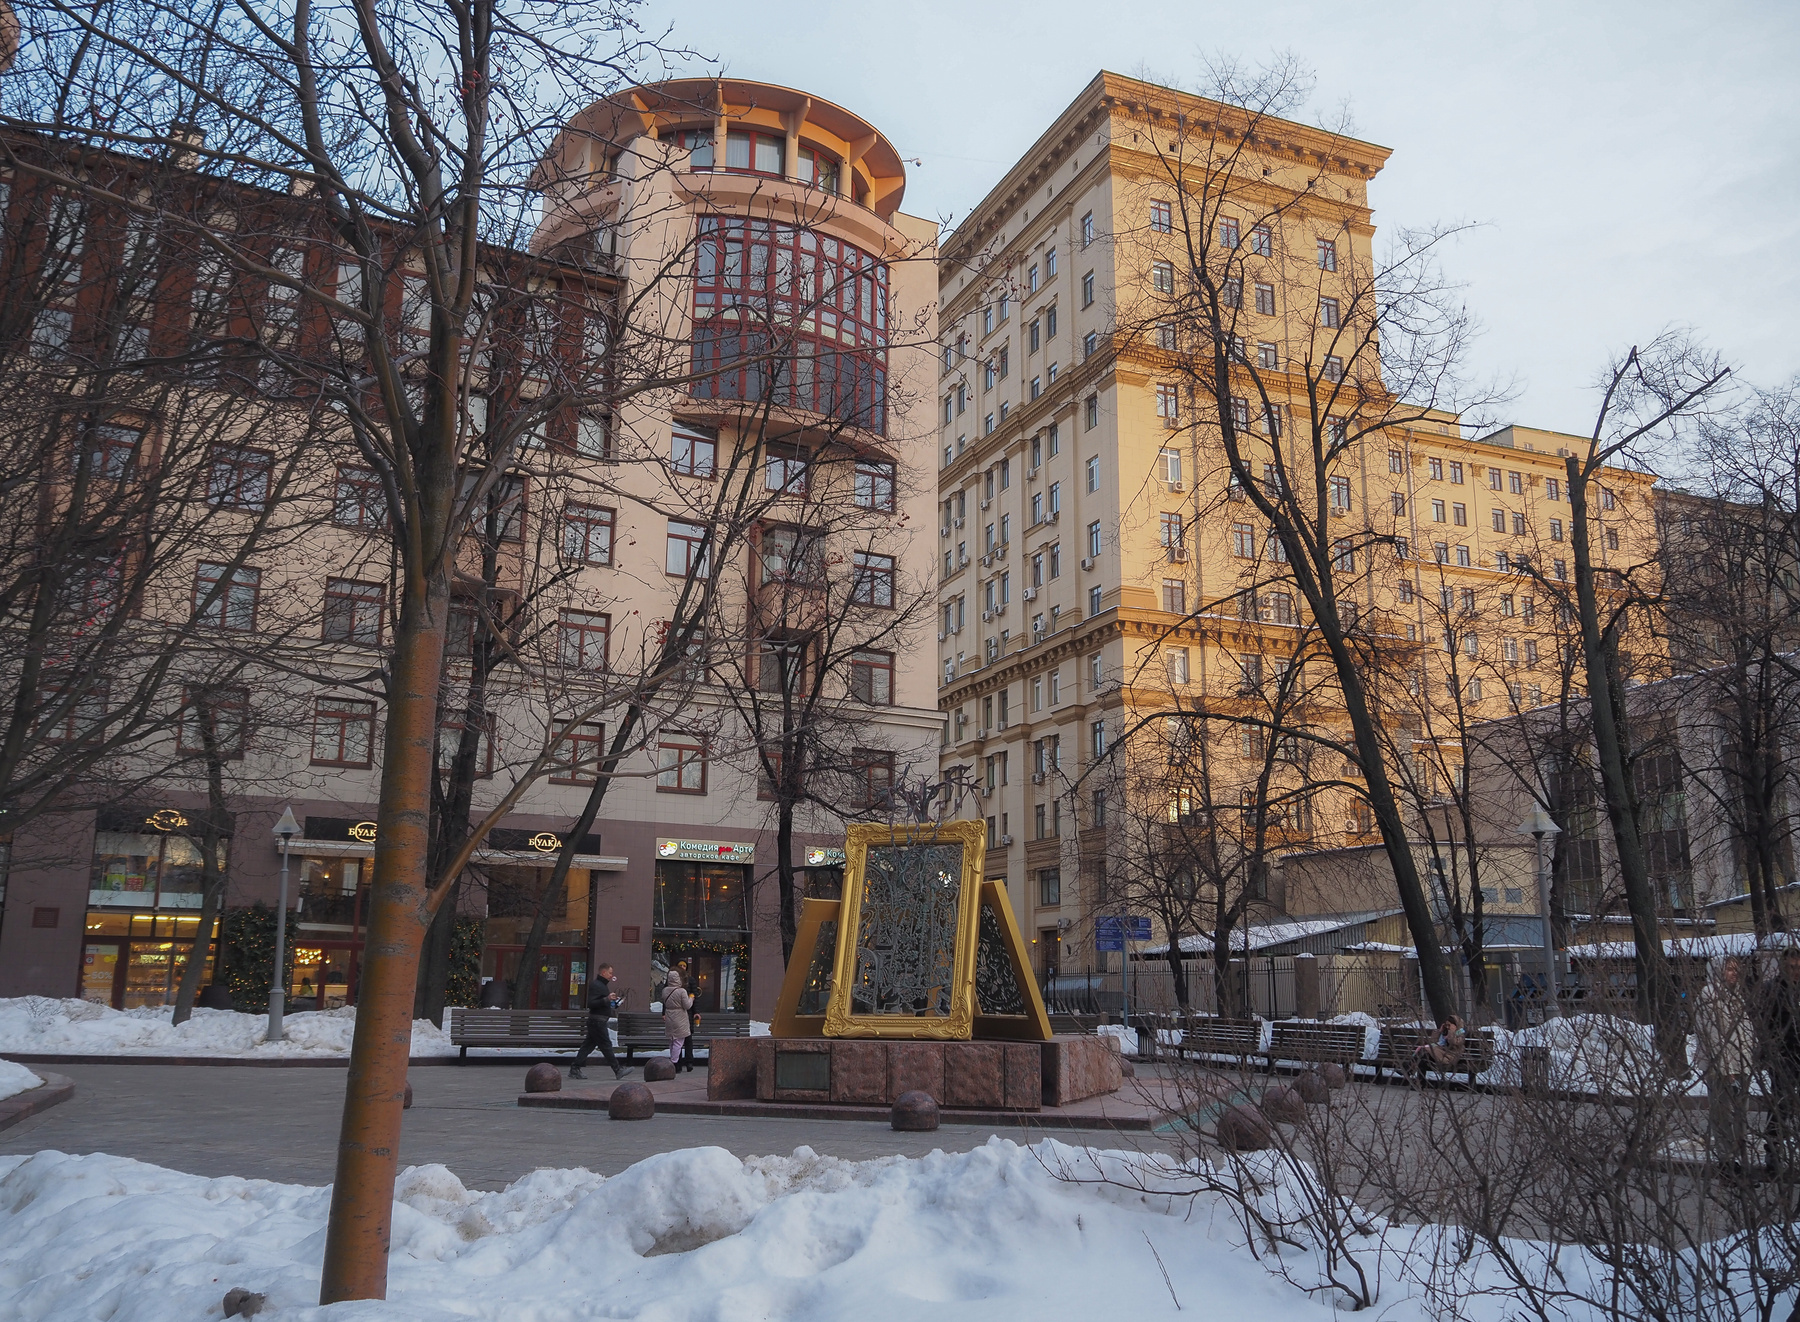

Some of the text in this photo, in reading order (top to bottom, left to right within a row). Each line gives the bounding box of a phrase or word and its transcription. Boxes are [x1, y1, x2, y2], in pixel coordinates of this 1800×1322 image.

[528, 836, 563, 849] БУЛКА
[680, 841, 718, 853] Комедия
[732, 844, 754, 855] Арте
[680, 852, 718, 860] авторское
